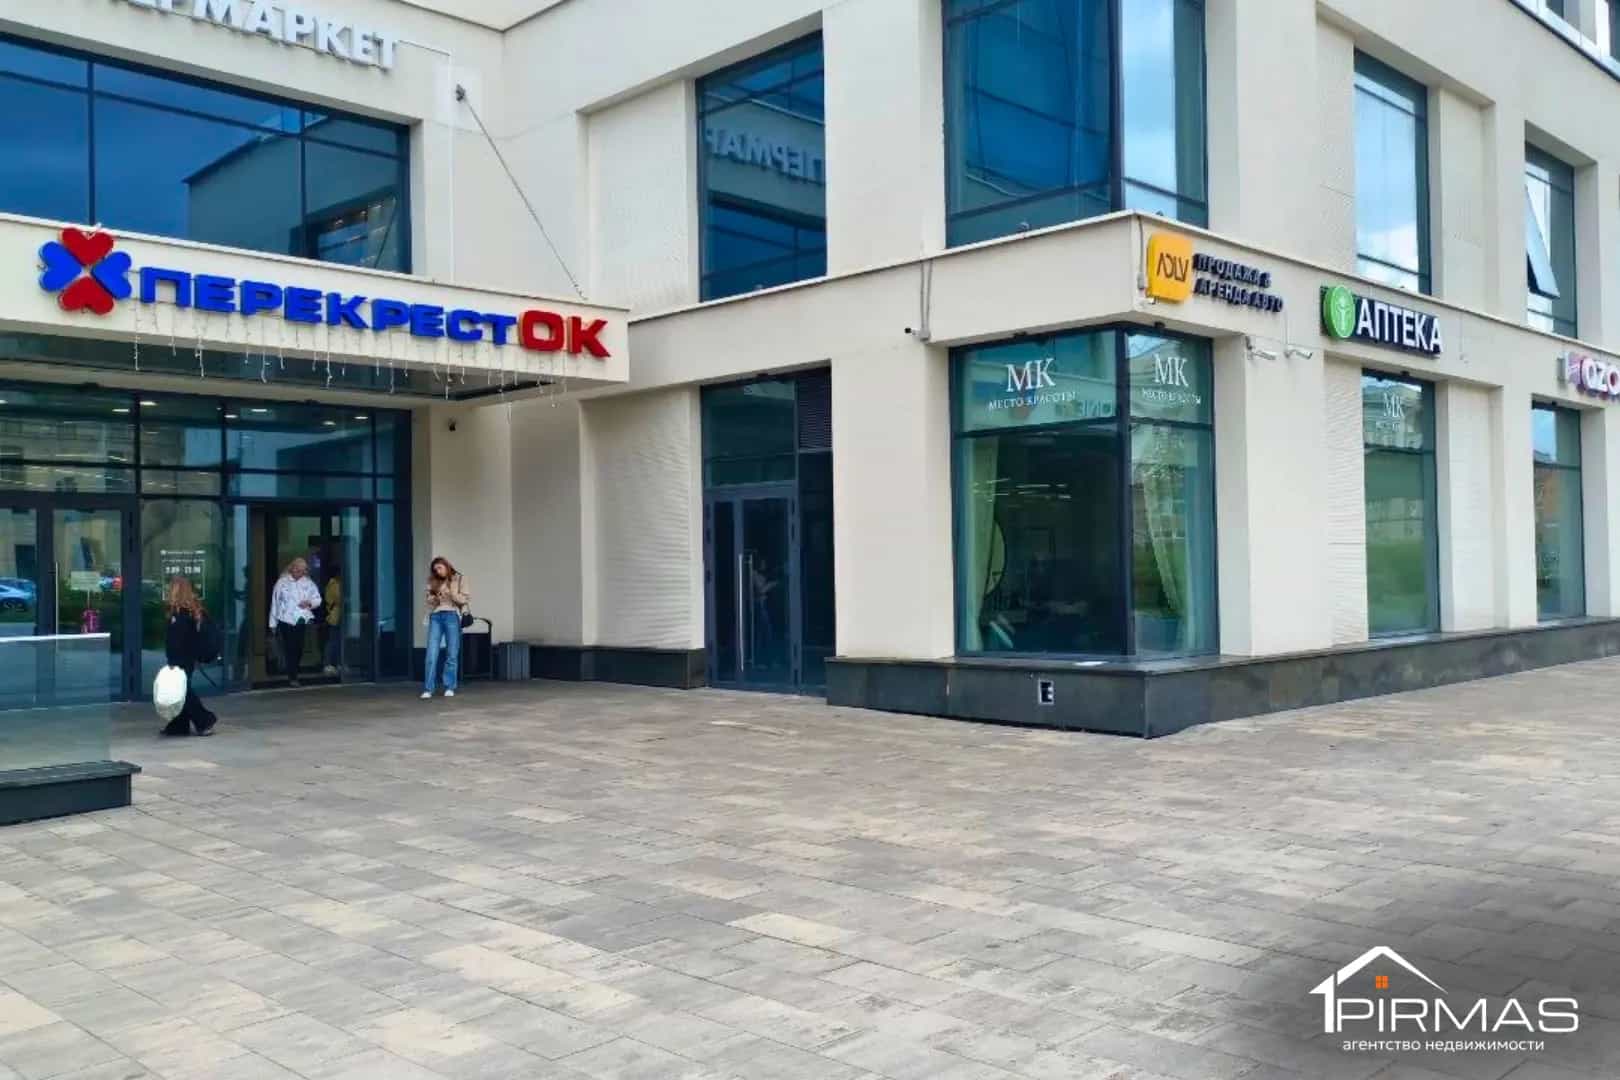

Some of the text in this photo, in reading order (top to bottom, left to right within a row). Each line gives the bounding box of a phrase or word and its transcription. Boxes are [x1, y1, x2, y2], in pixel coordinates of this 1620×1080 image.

[128, 0, 396, 70] МАРКЕТ
[139, 266, 610, 358] ПЕРЕКРЕСТОК
[1356, 298, 1444, 353] АПТЕКА
[1005, 358, 1057, 393] МК
[1152, 353, 1189, 387] МК
